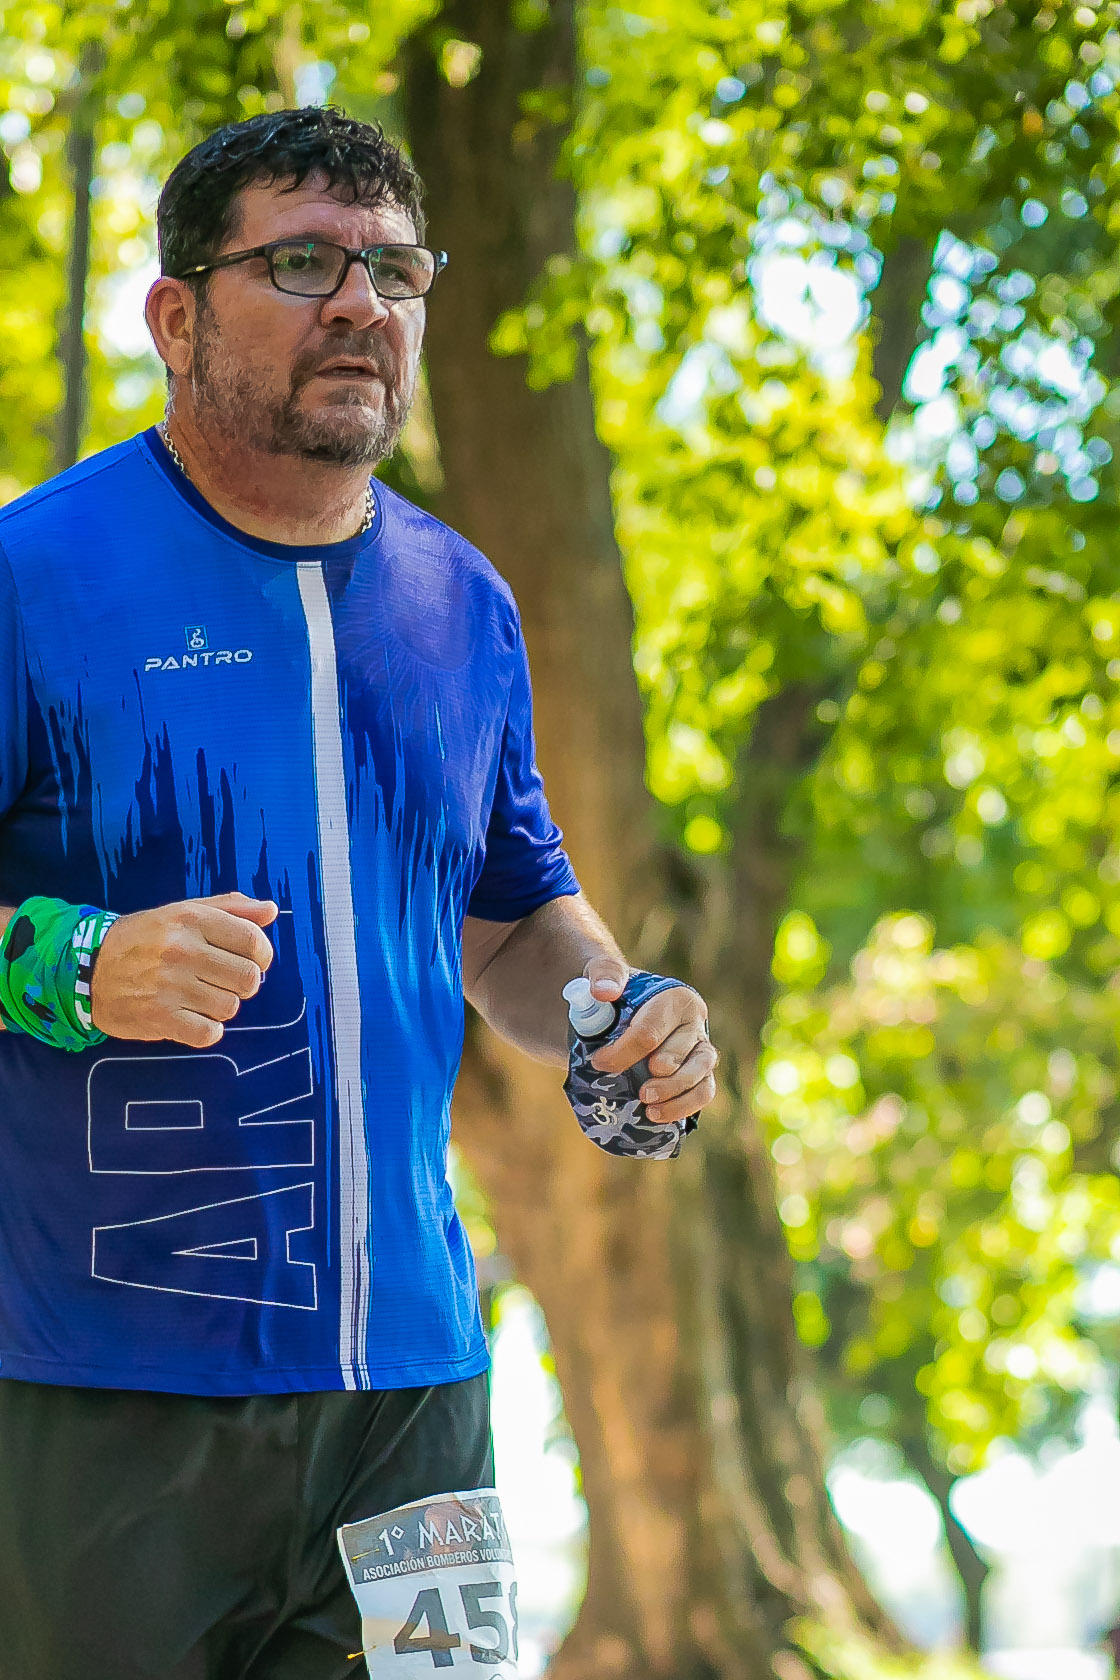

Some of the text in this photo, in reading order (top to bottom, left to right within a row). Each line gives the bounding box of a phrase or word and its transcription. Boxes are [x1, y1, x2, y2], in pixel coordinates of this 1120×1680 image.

[144, 649, 253, 672] PANTRO
[417, 1512, 508, 1549] MARAT
[363, 1555, 426, 1581] ASOCIACIÓN
[427, 1549, 479, 1567] BOMBEROS
